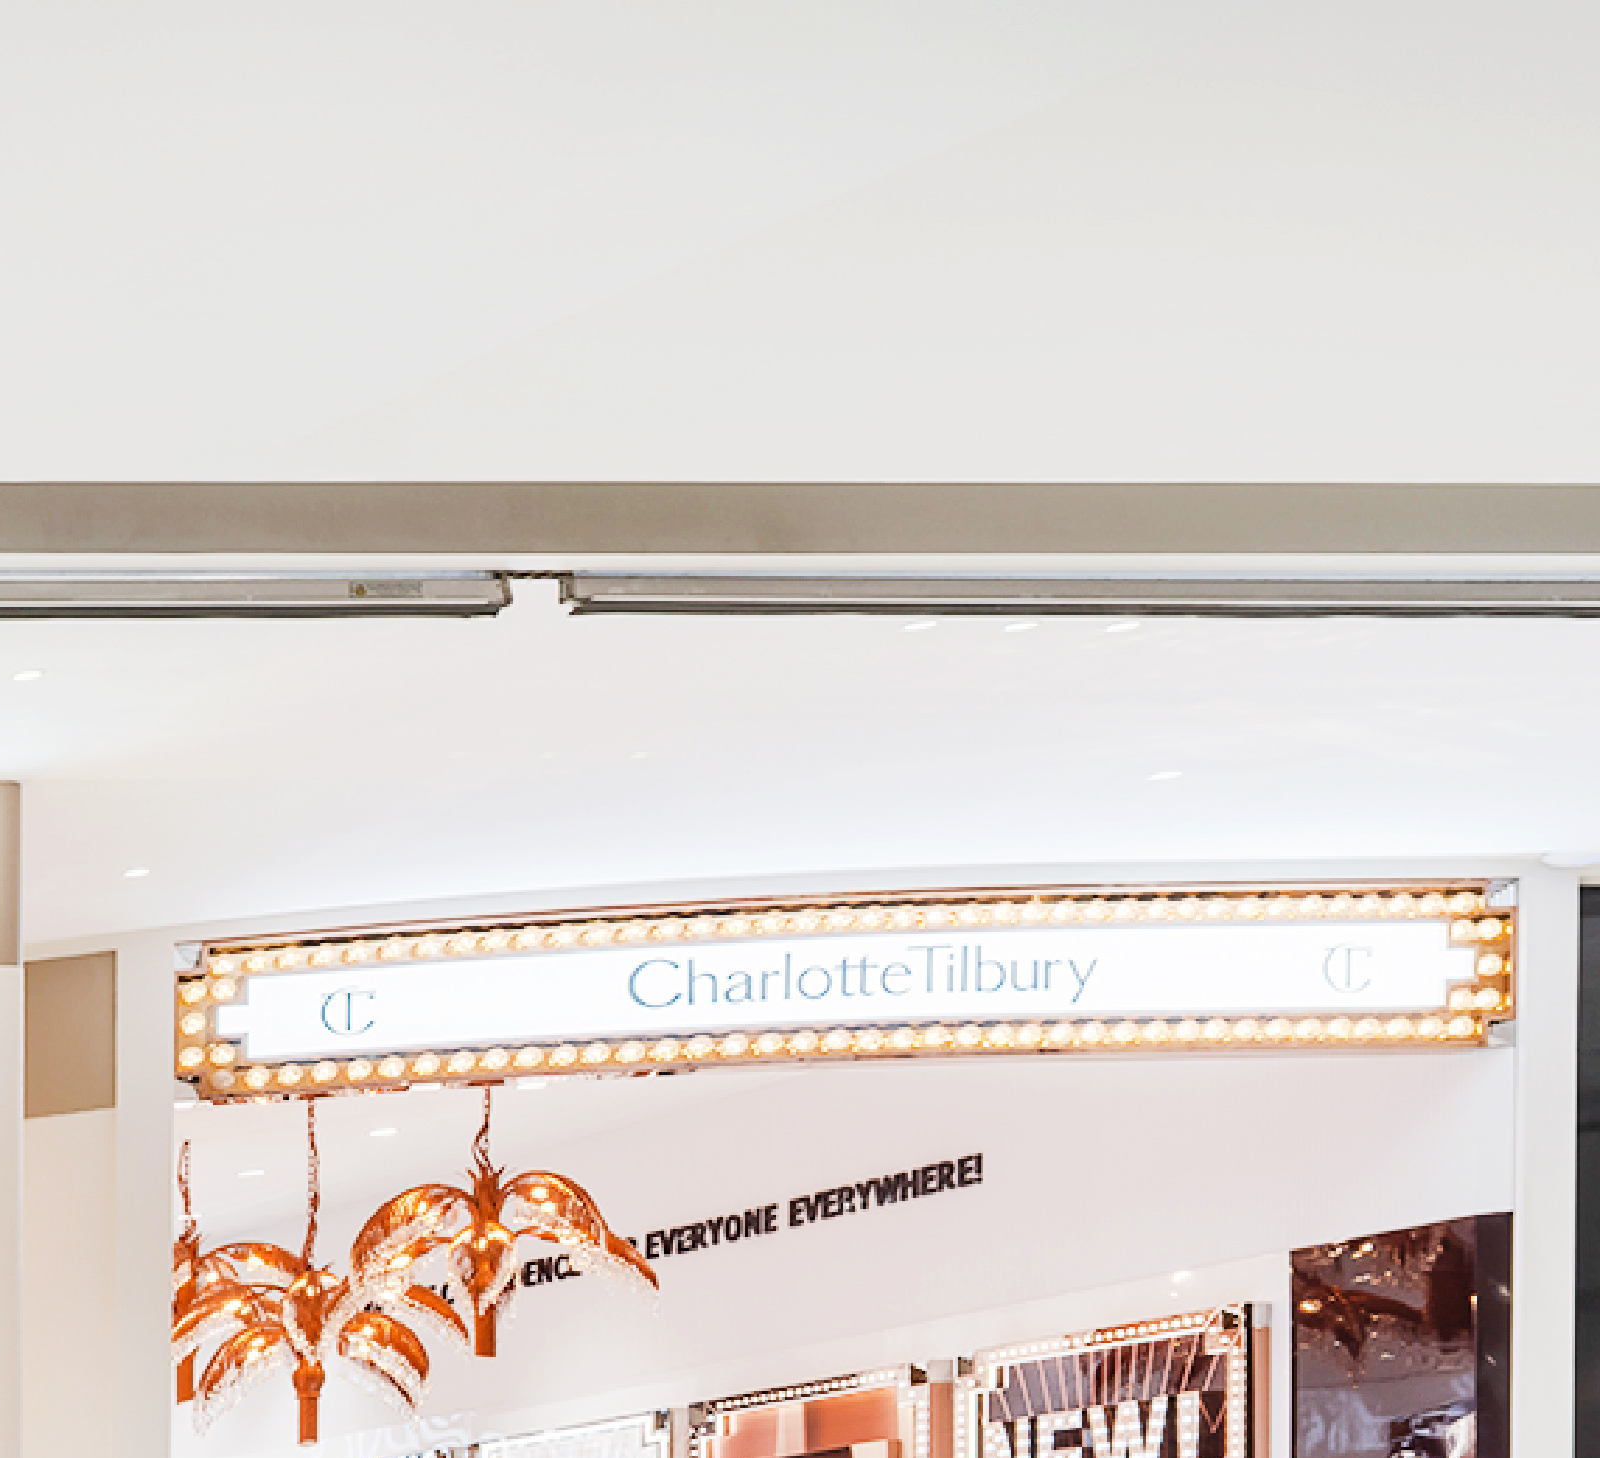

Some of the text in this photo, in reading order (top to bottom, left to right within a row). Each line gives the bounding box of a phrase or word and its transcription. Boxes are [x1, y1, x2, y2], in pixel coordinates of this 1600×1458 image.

[627, 944, 1099, 1011] CharlotteTilbury
[644, 1152, 984, 1261] EVERYONE EVERYWHERE!
